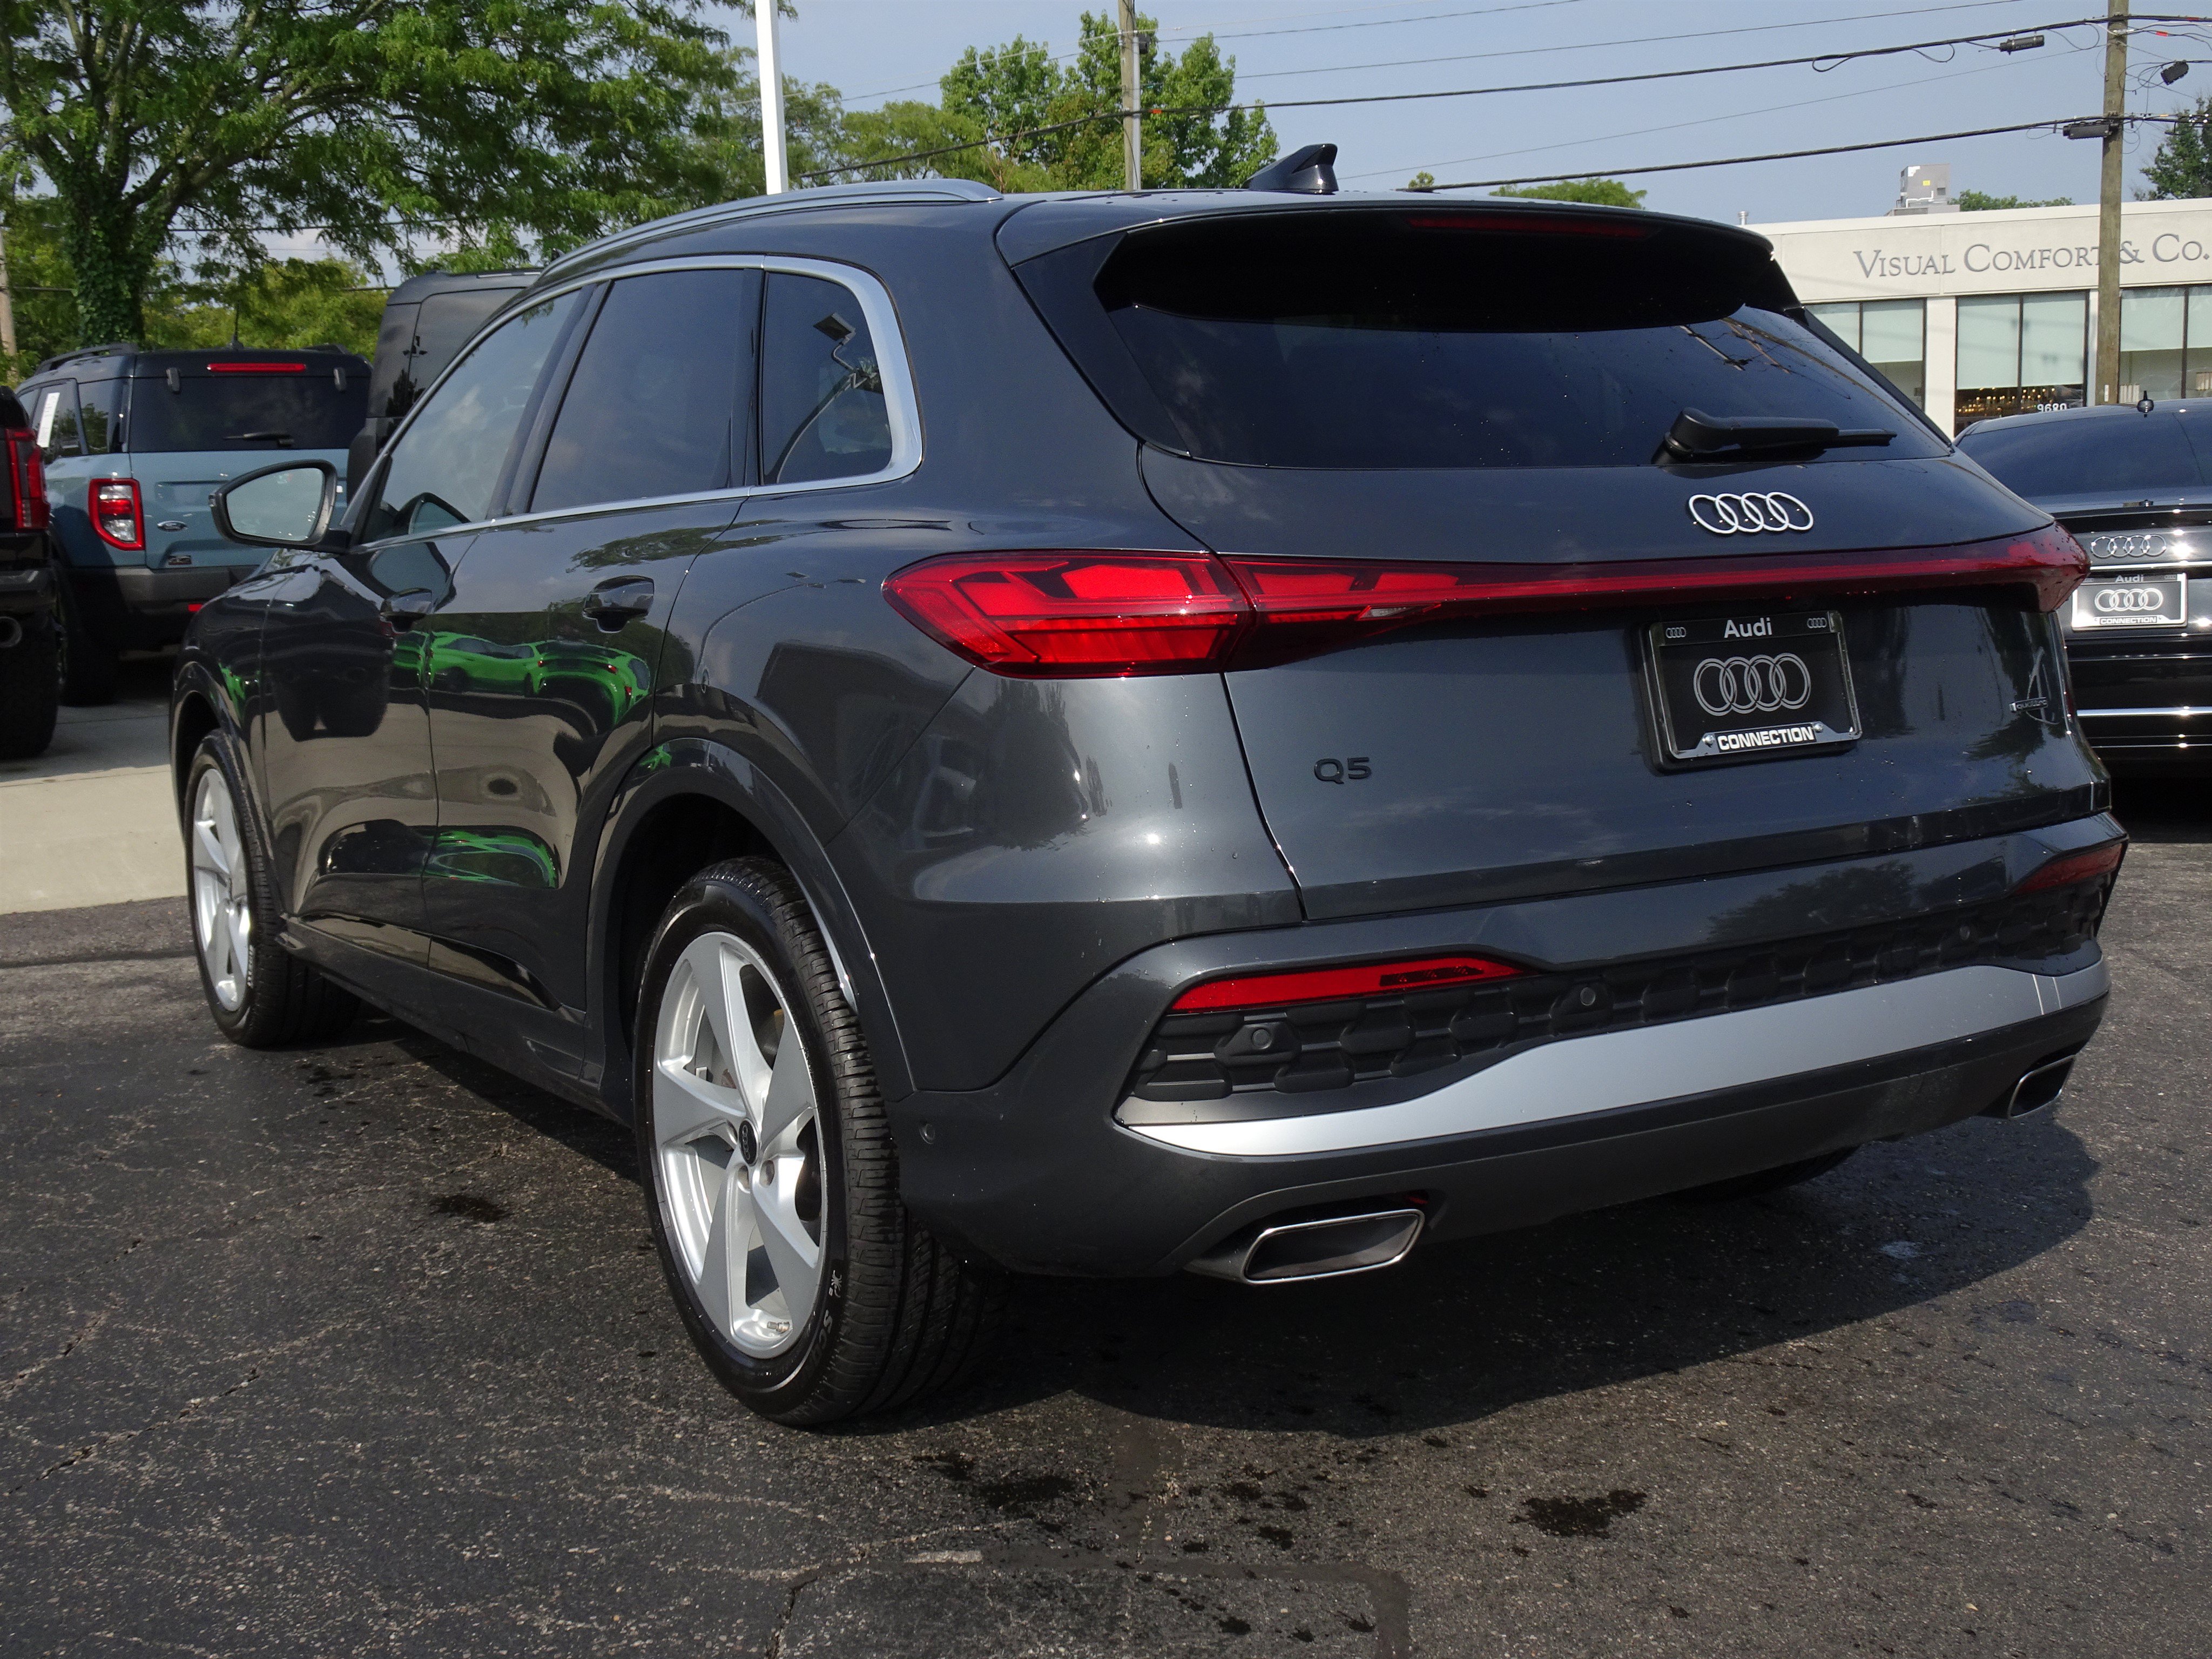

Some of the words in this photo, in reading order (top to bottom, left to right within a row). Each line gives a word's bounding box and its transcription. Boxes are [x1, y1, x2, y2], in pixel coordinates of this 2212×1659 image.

[1852, 249, 1957, 279] VISUAL
[2119, 240, 2145, 264] &
[2152, 233, 2210, 262] CO.
[2115, 574, 2144, 583] Audi
[1724, 617, 1772, 638] Audi
[2100, 617, 2157, 625] CONNECTION
[1717, 726, 1815, 751] CONNECTION
[1313, 757, 1372, 784] Q5
